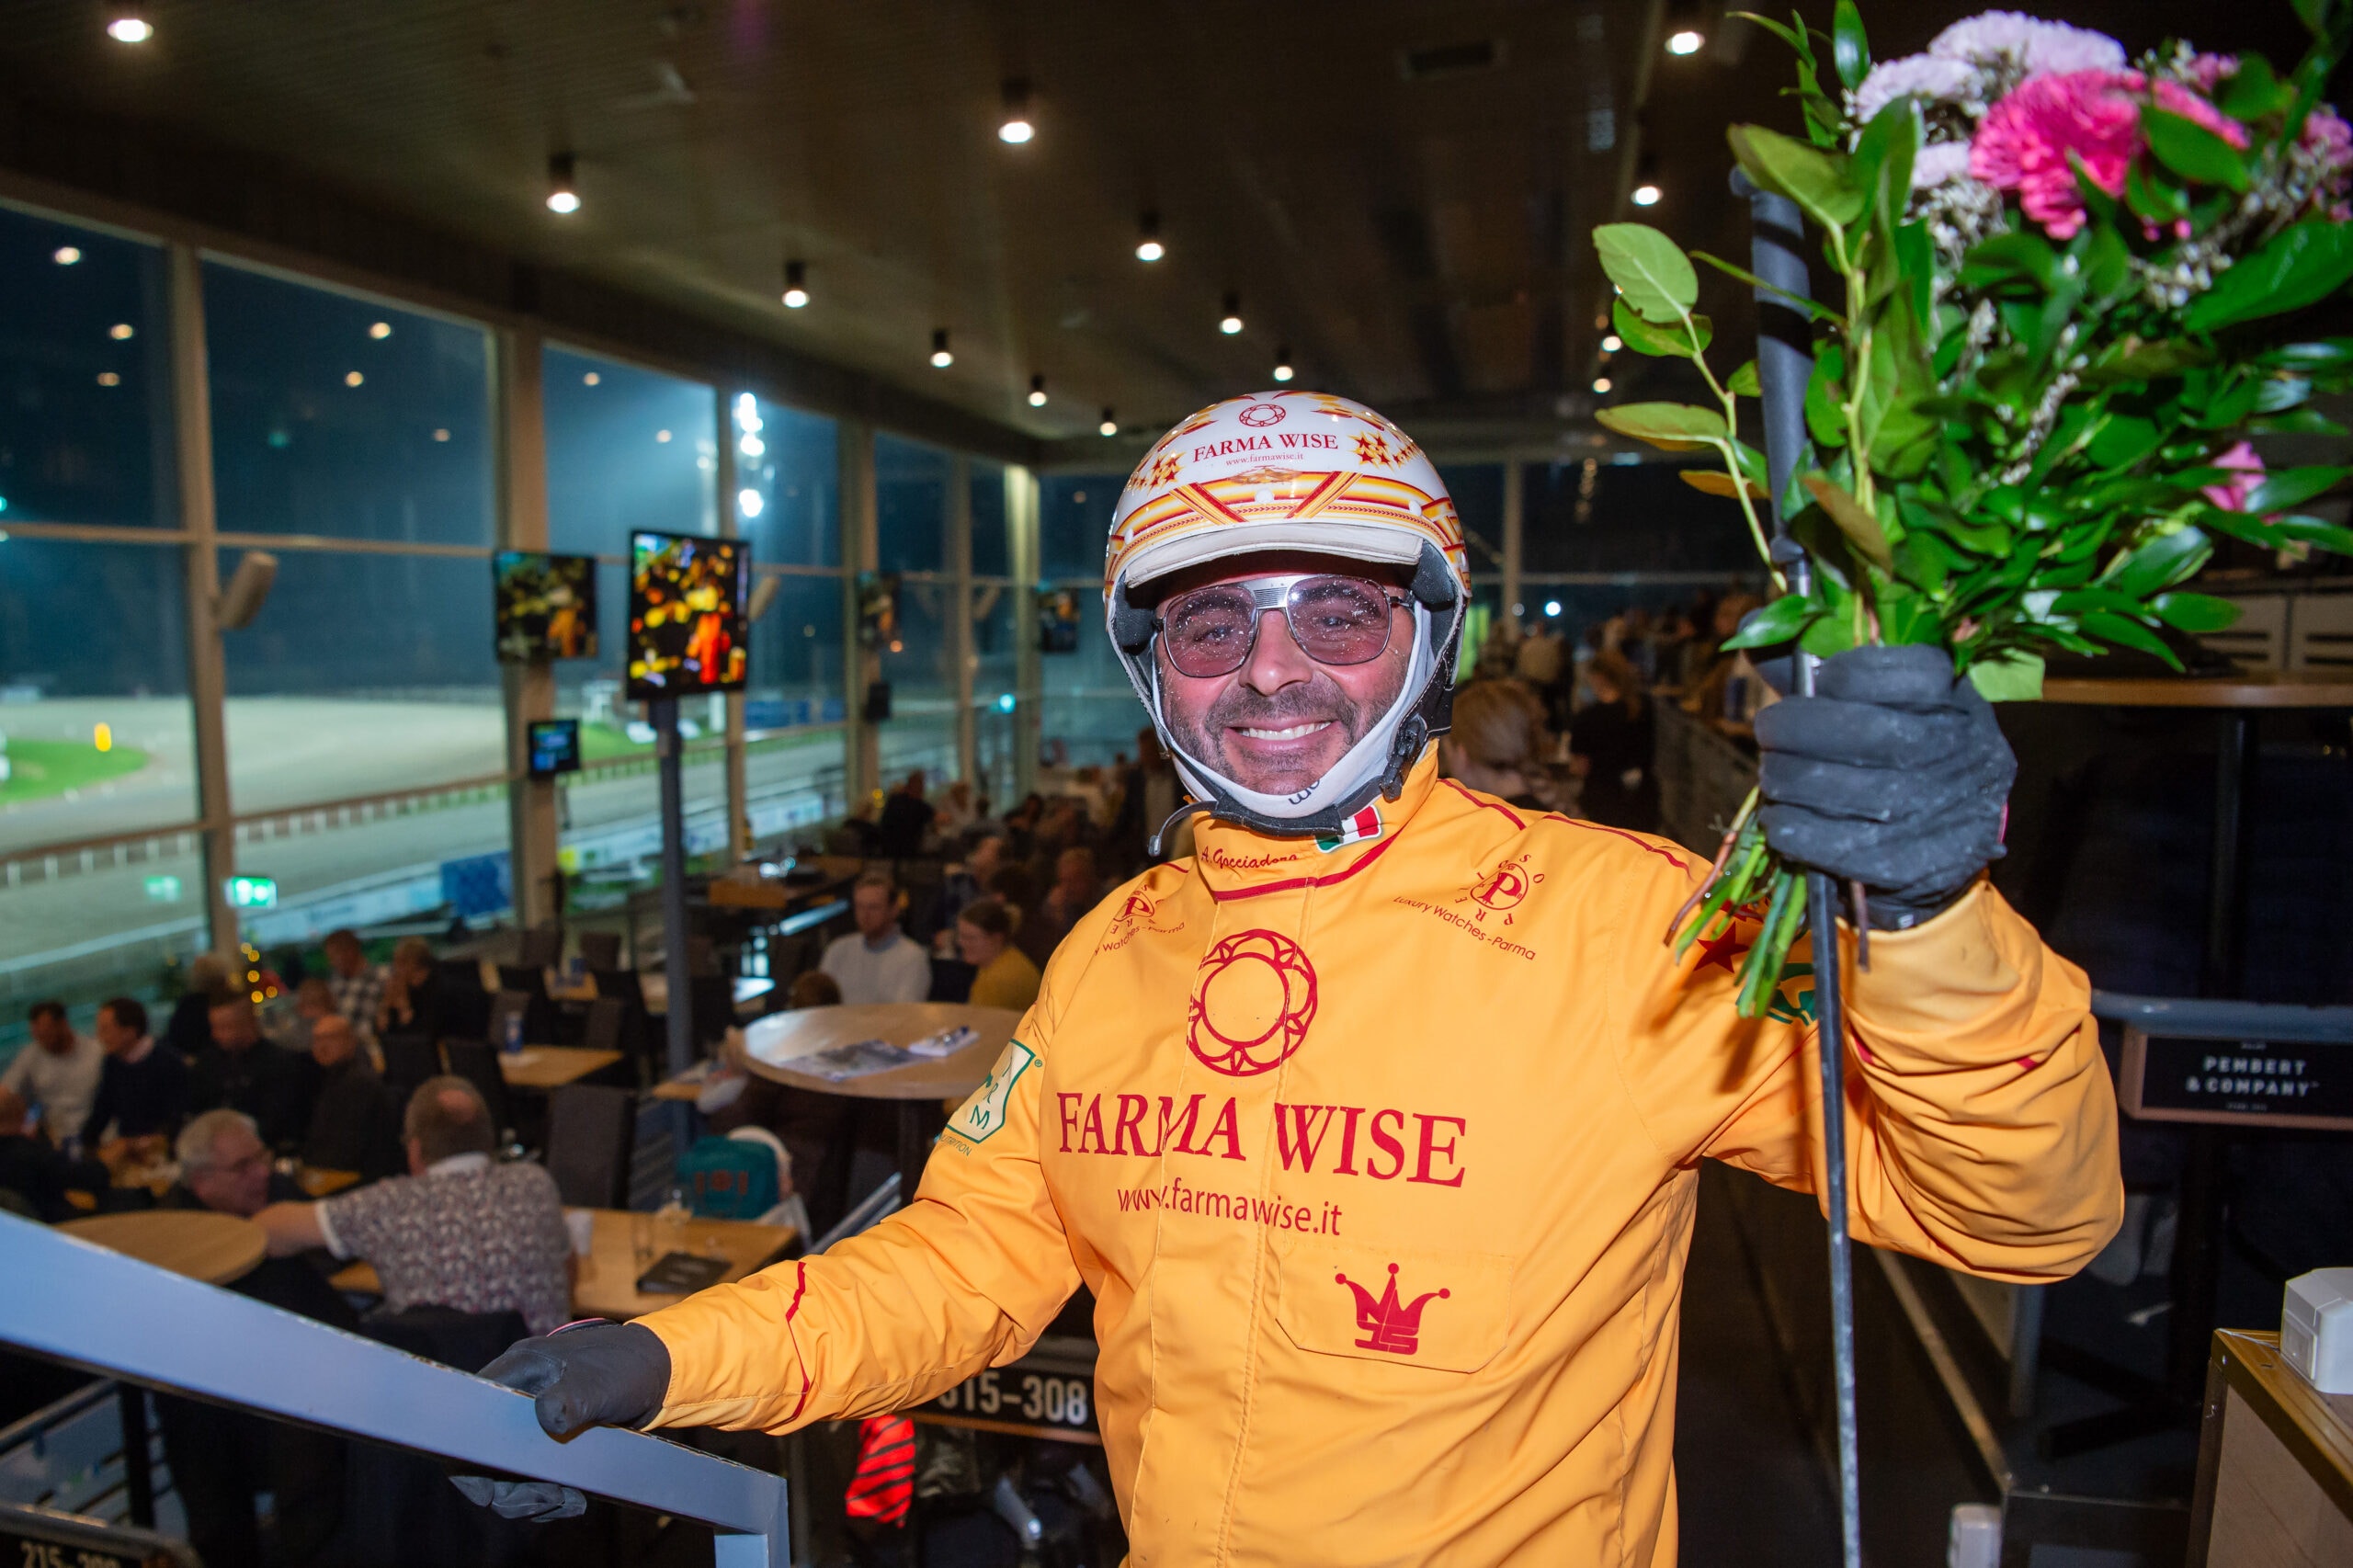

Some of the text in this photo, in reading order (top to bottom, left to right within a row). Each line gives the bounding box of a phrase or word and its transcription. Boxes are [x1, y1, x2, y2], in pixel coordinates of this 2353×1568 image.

[1193, 434, 1338, 462] FARMA WISE
[1225, 452, 1304, 466] www.farmawise.it
[1393, 896, 1432, 913] Luxury
[1433, 905, 1486, 941] Watches
[1103, 926, 1140, 952] Watches
[2186, 1076, 2309, 1096] & COMPANY
[1057, 1092, 1466, 1187] FARMA WISE
[1118, 1177, 1342, 1236] www.farmawise.it
